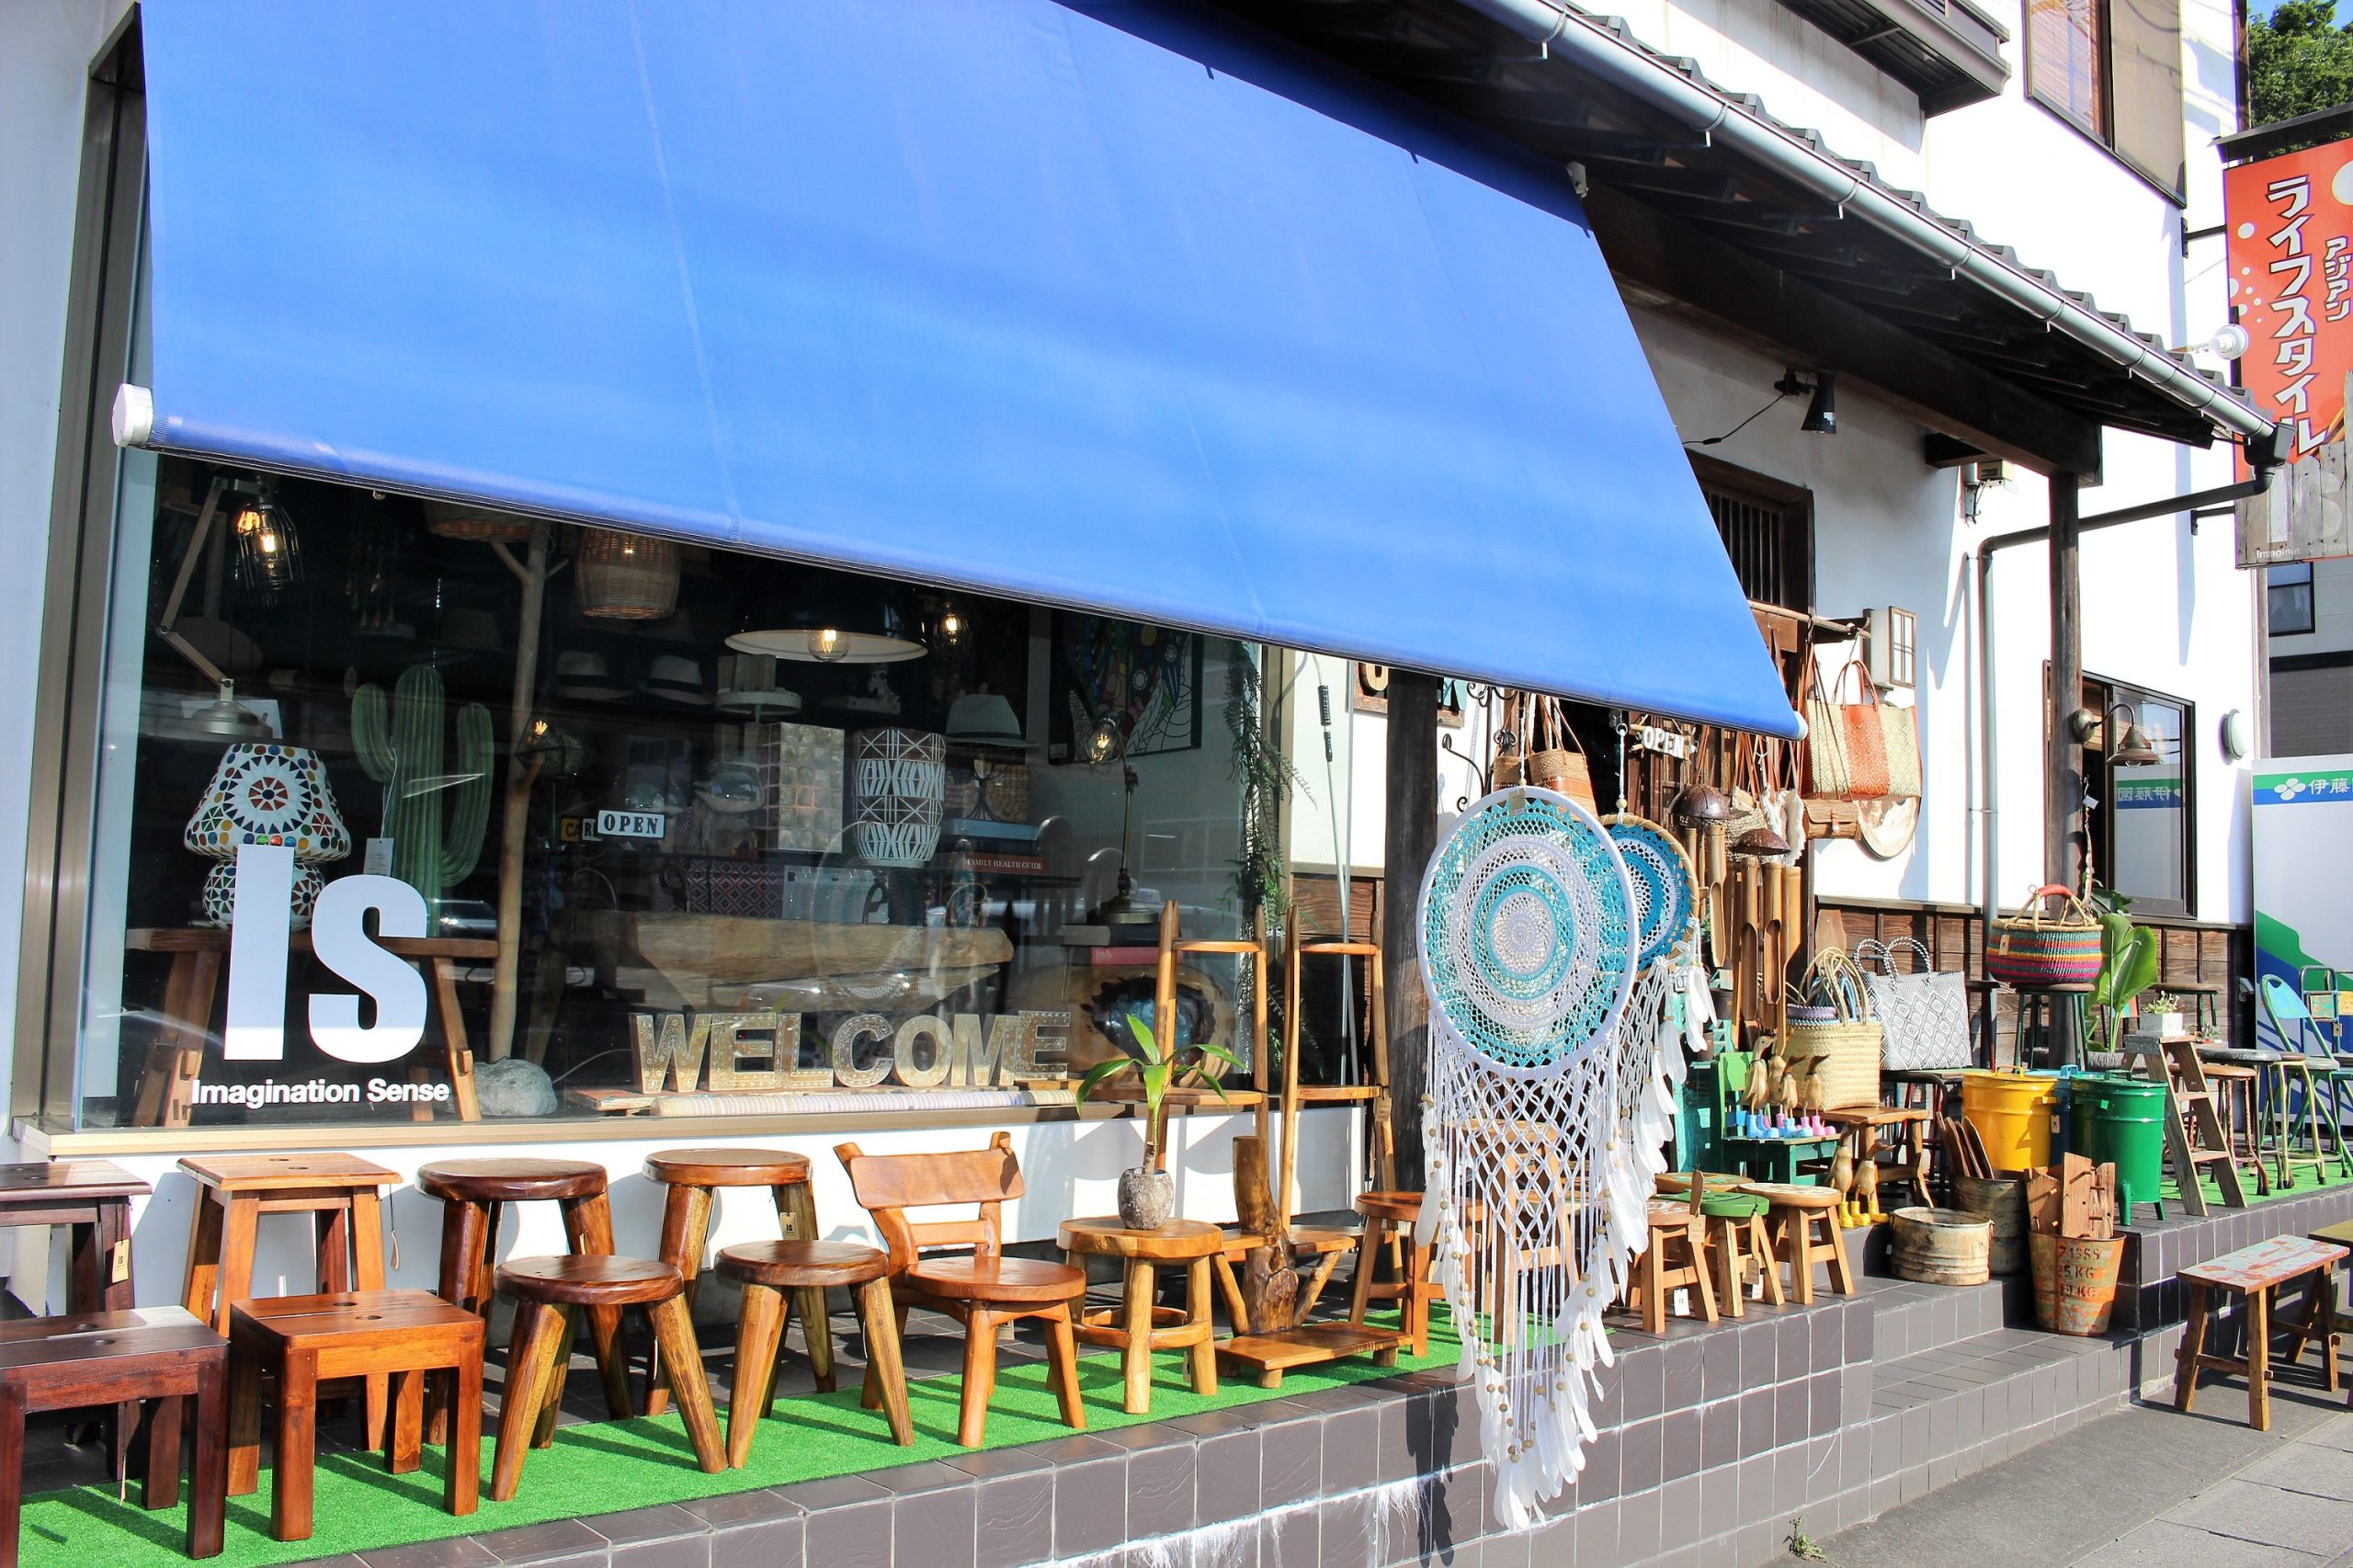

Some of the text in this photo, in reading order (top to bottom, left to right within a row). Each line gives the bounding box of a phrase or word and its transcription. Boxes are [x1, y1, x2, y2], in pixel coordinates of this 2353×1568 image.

[2324, 235, 2353, 322] アジアン
[1642, 726, 1685, 758] OPEN
[2308, 778, 2353, 795] 伊藤
[603, 813, 658, 835] OPEN
[966, 858, 993, 868] FAMILY
[993, 859, 1022, 869] HEALTH
[634, 1010, 1071, 1094] WELCOME
[191, 1077, 449, 1109] Imagination Sense
